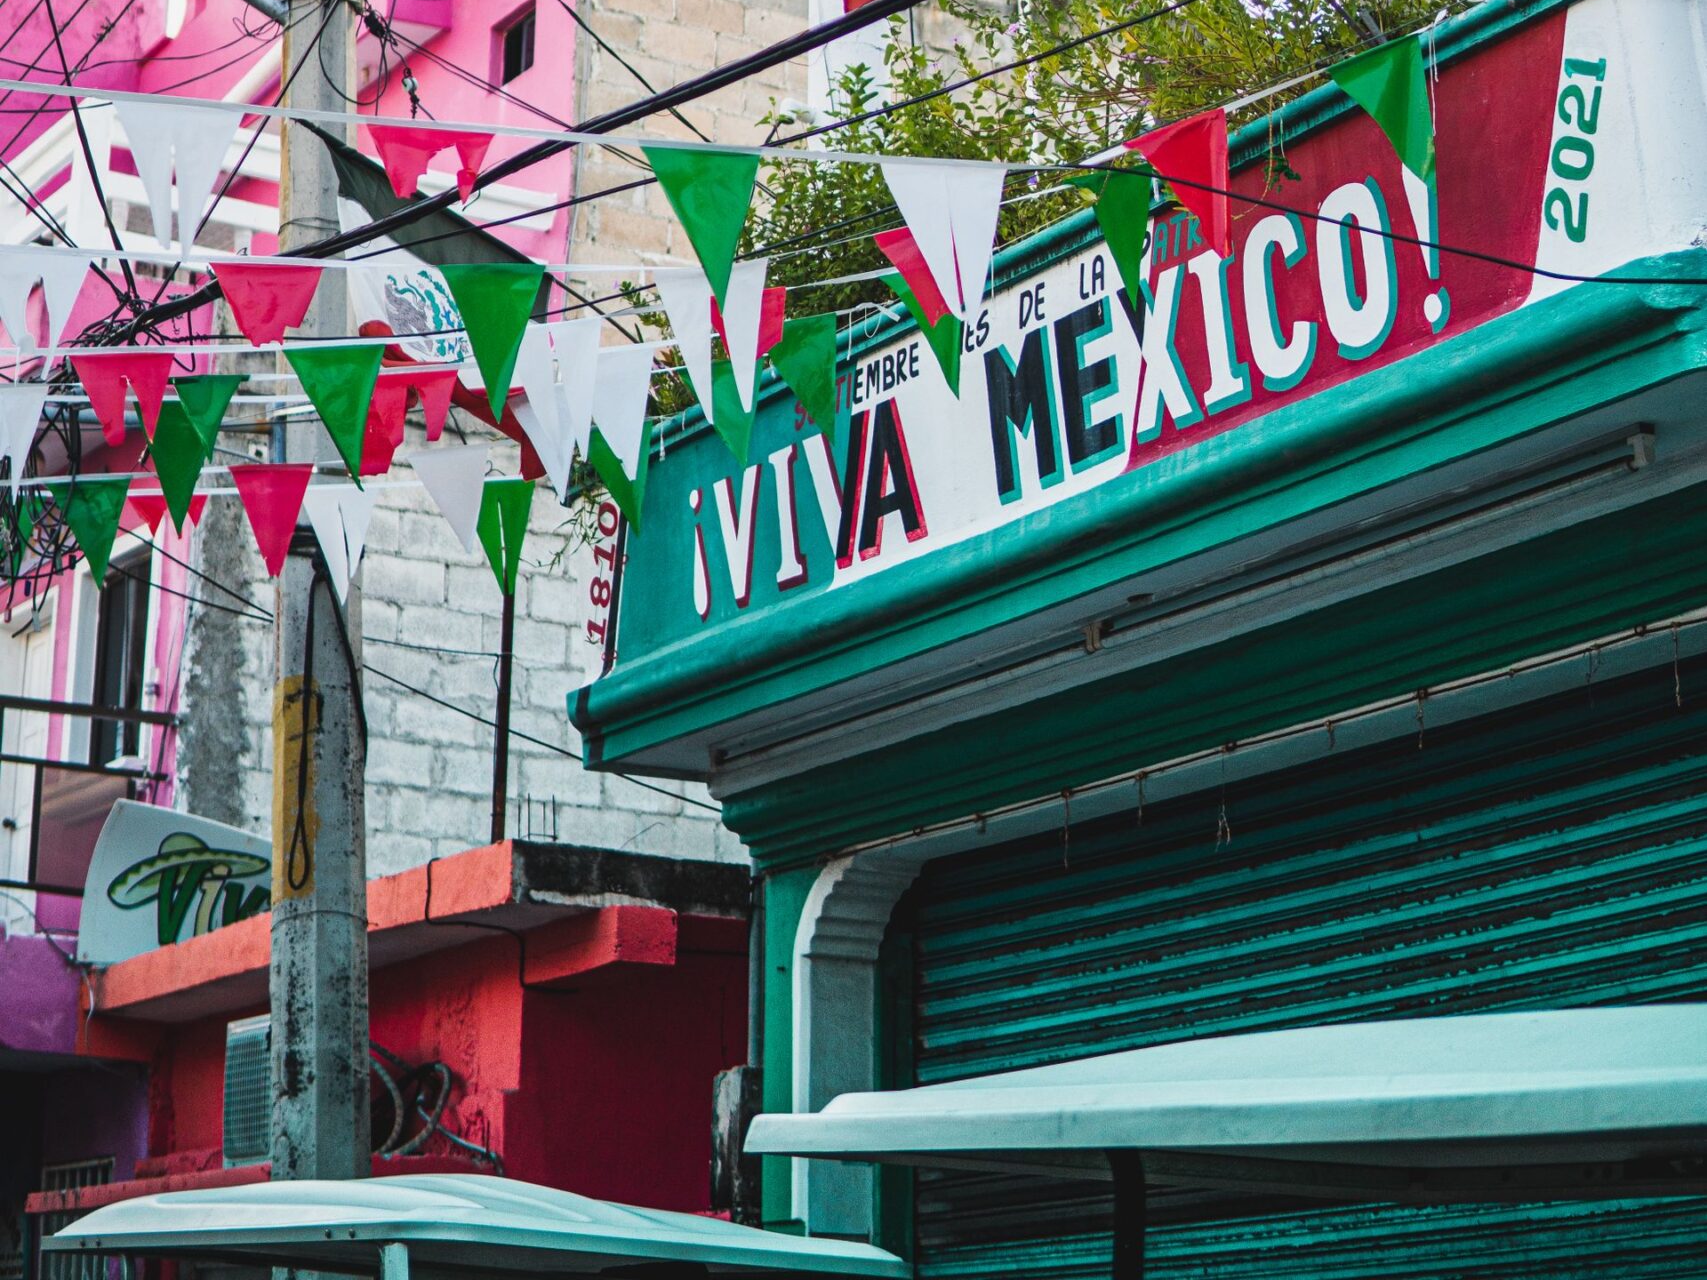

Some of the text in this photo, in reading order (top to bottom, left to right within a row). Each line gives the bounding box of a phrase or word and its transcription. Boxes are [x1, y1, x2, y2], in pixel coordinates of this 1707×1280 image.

[1544, 58, 1607, 243] 2021
[689, 161, 1451, 623] ¡VIVA MEXICO!
[794, 341, 920, 431] STIEMBRE
[959, 309, 990, 356] ES
[1019, 282, 1046, 330] DE
[1079, 254, 1105, 300] LA
[586, 501, 619, 645] 1810
